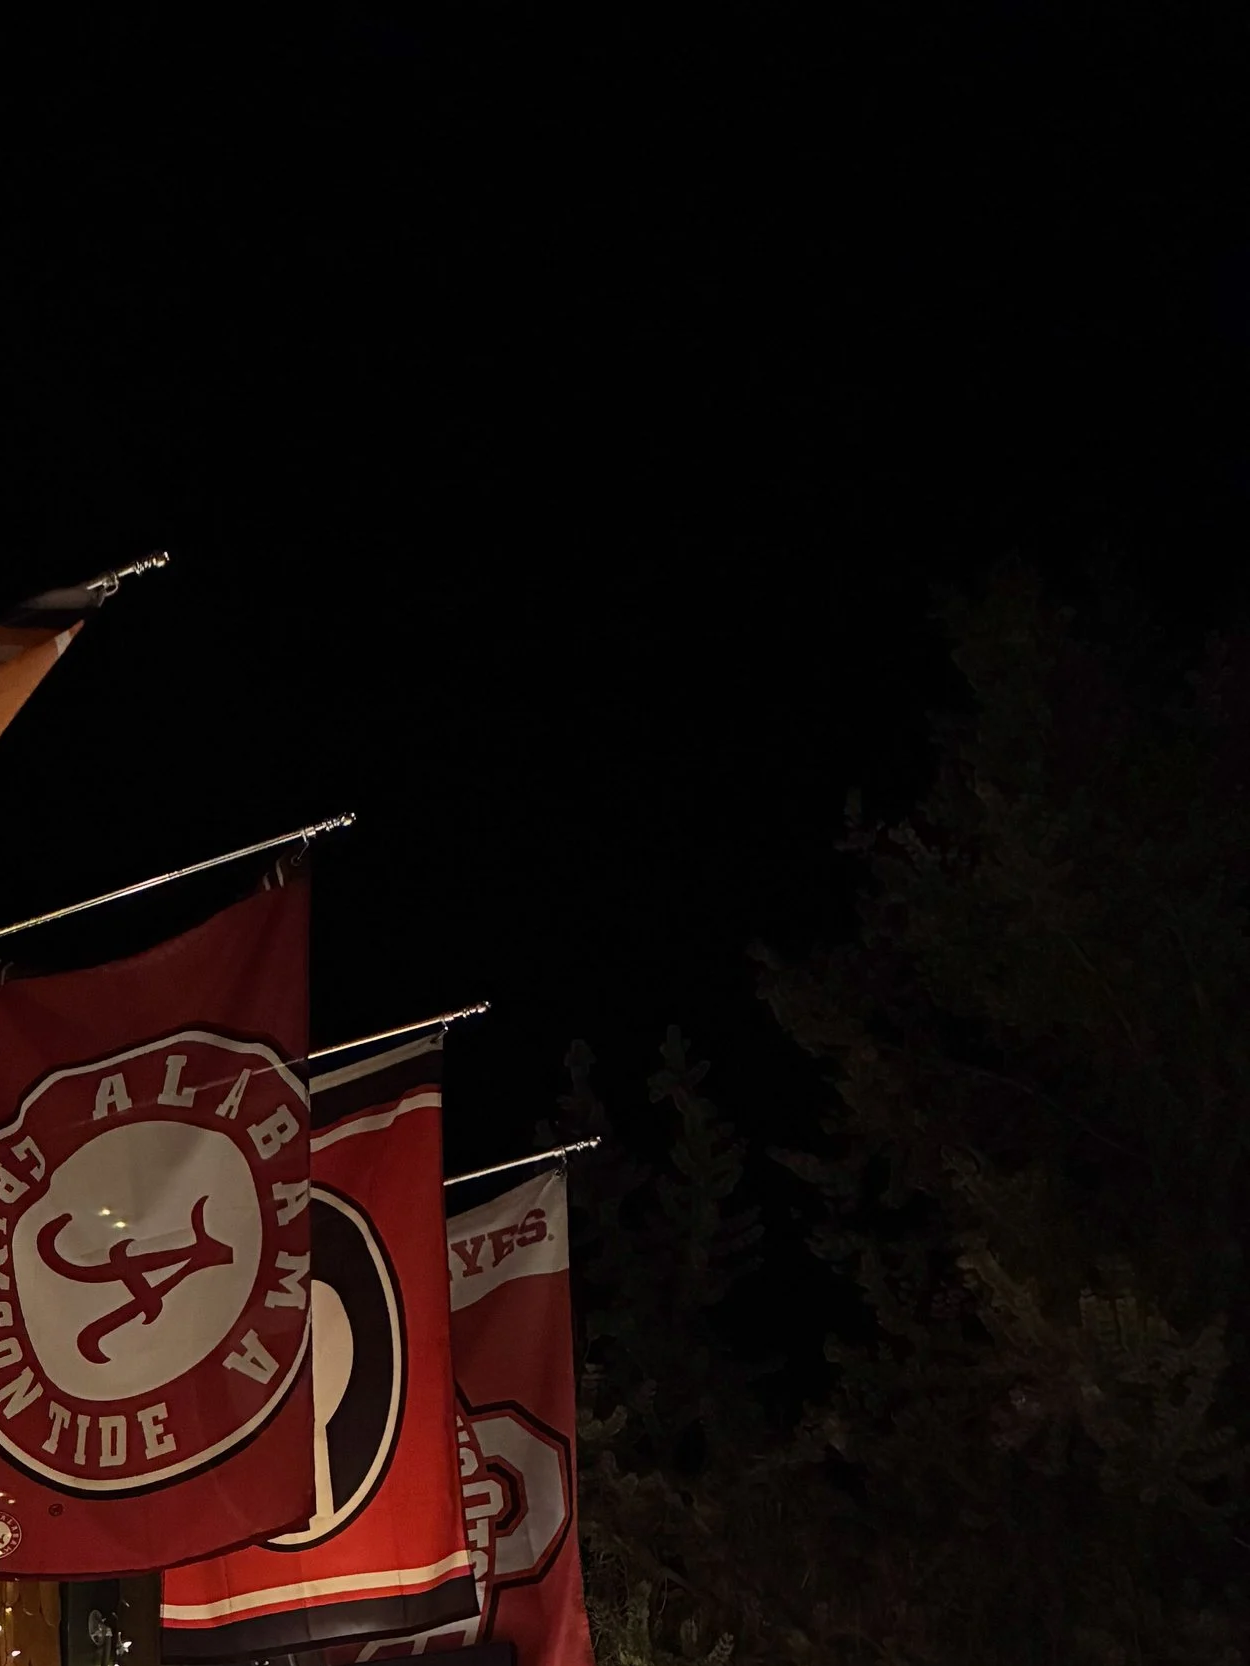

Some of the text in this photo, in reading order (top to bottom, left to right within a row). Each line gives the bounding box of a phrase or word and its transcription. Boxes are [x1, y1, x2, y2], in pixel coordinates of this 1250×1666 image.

[93, 1054, 311, 1385] ALABAMA
[448, 1207, 548, 1282] YES
[41, 1400, 178, 1468] TIDE
